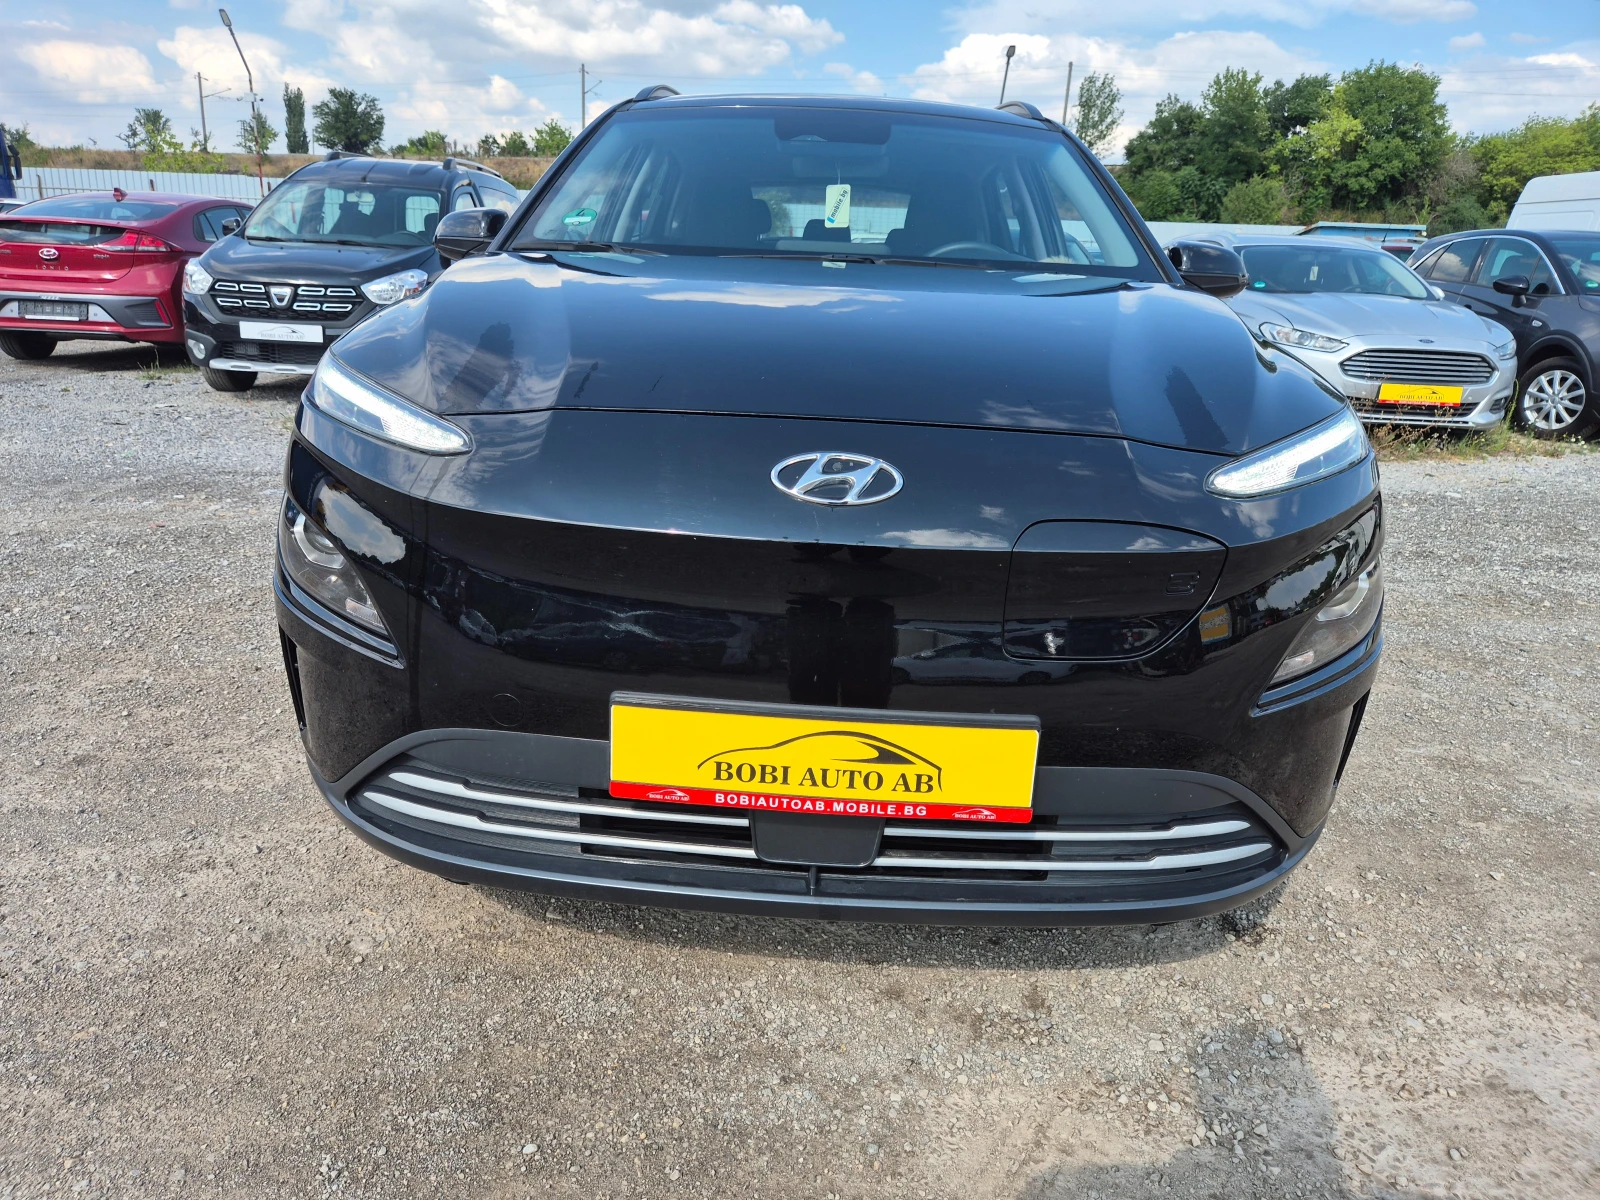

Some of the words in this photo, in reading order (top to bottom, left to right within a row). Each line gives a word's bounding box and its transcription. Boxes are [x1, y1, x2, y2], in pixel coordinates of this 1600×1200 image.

[576, 209, 585, 217] 4
[830, 189, 848, 219] mobile.bg
[713, 761, 791, 786] BOBI
[798, 767, 884, 791] AUTO
[891, 772, 934, 793] AB
[715, 793, 928, 817] BOBIAUTOAB.MOBILE.BG
